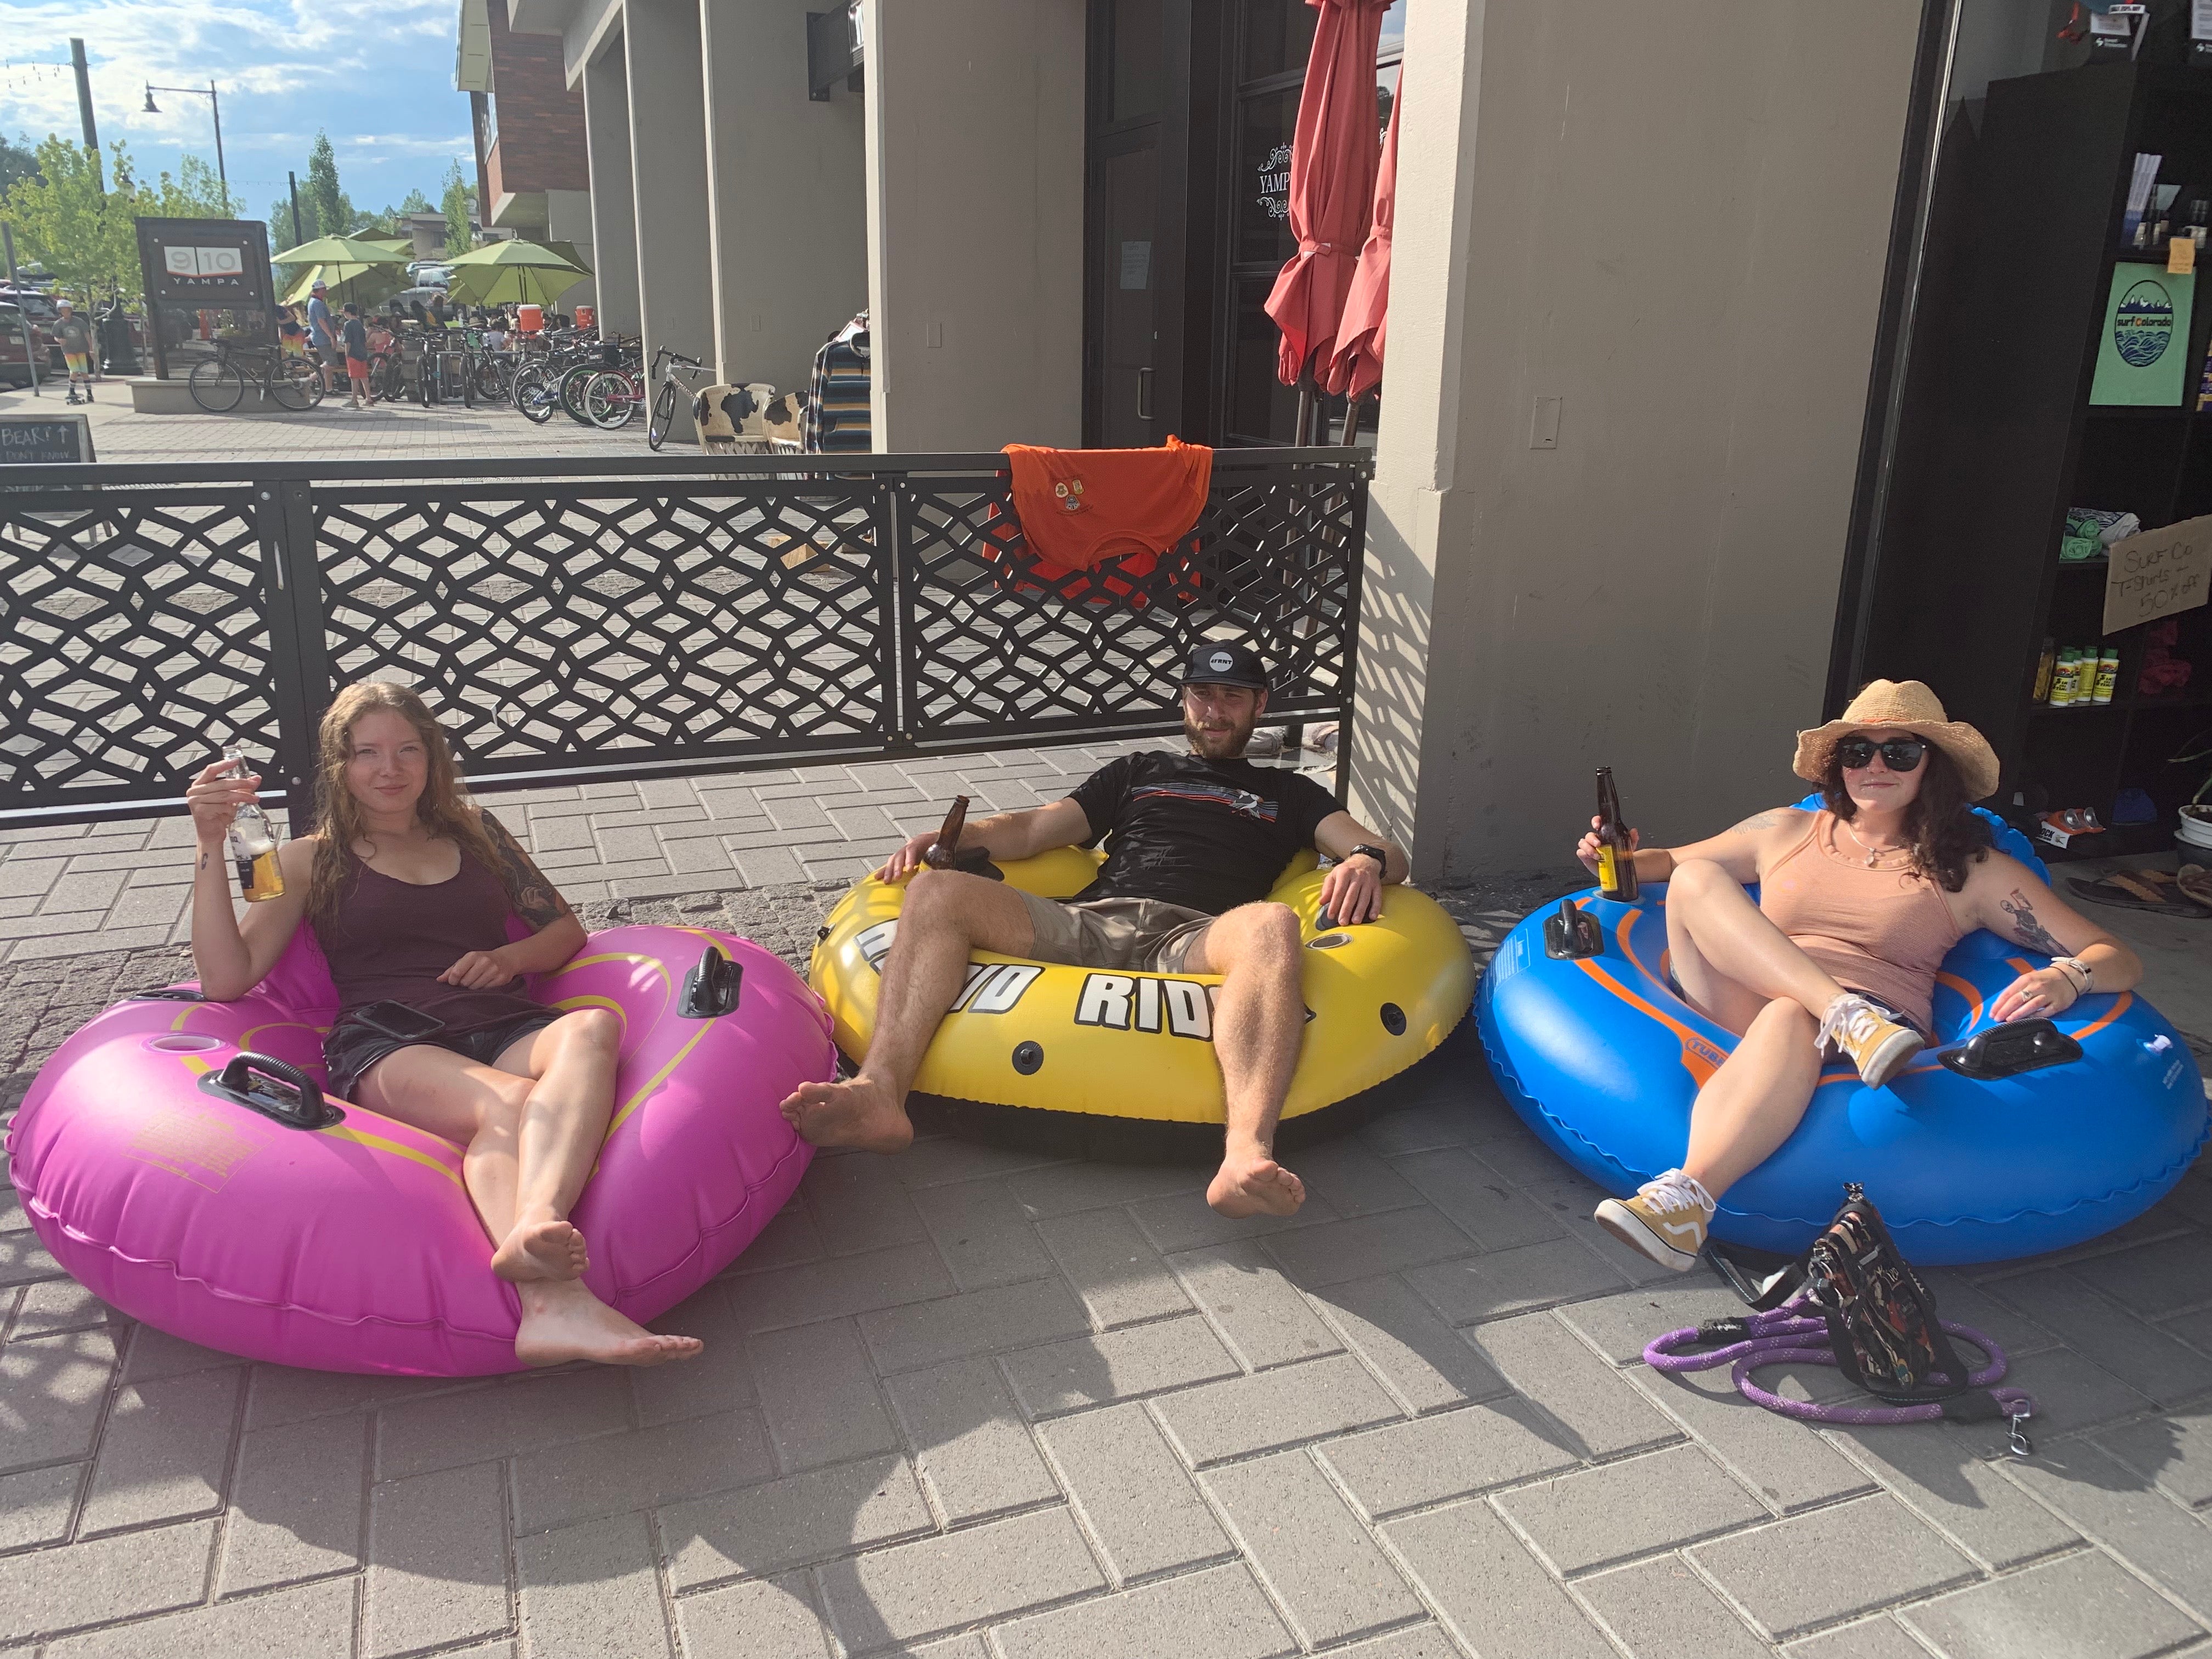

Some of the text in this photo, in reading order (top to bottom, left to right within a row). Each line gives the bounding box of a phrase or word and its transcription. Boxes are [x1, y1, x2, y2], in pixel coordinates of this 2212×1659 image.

[1260, 172, 1290, 194] YAMP
[174, 278, 240, 286] YAMPA
[1074, 973, 1317, 1042] RID
